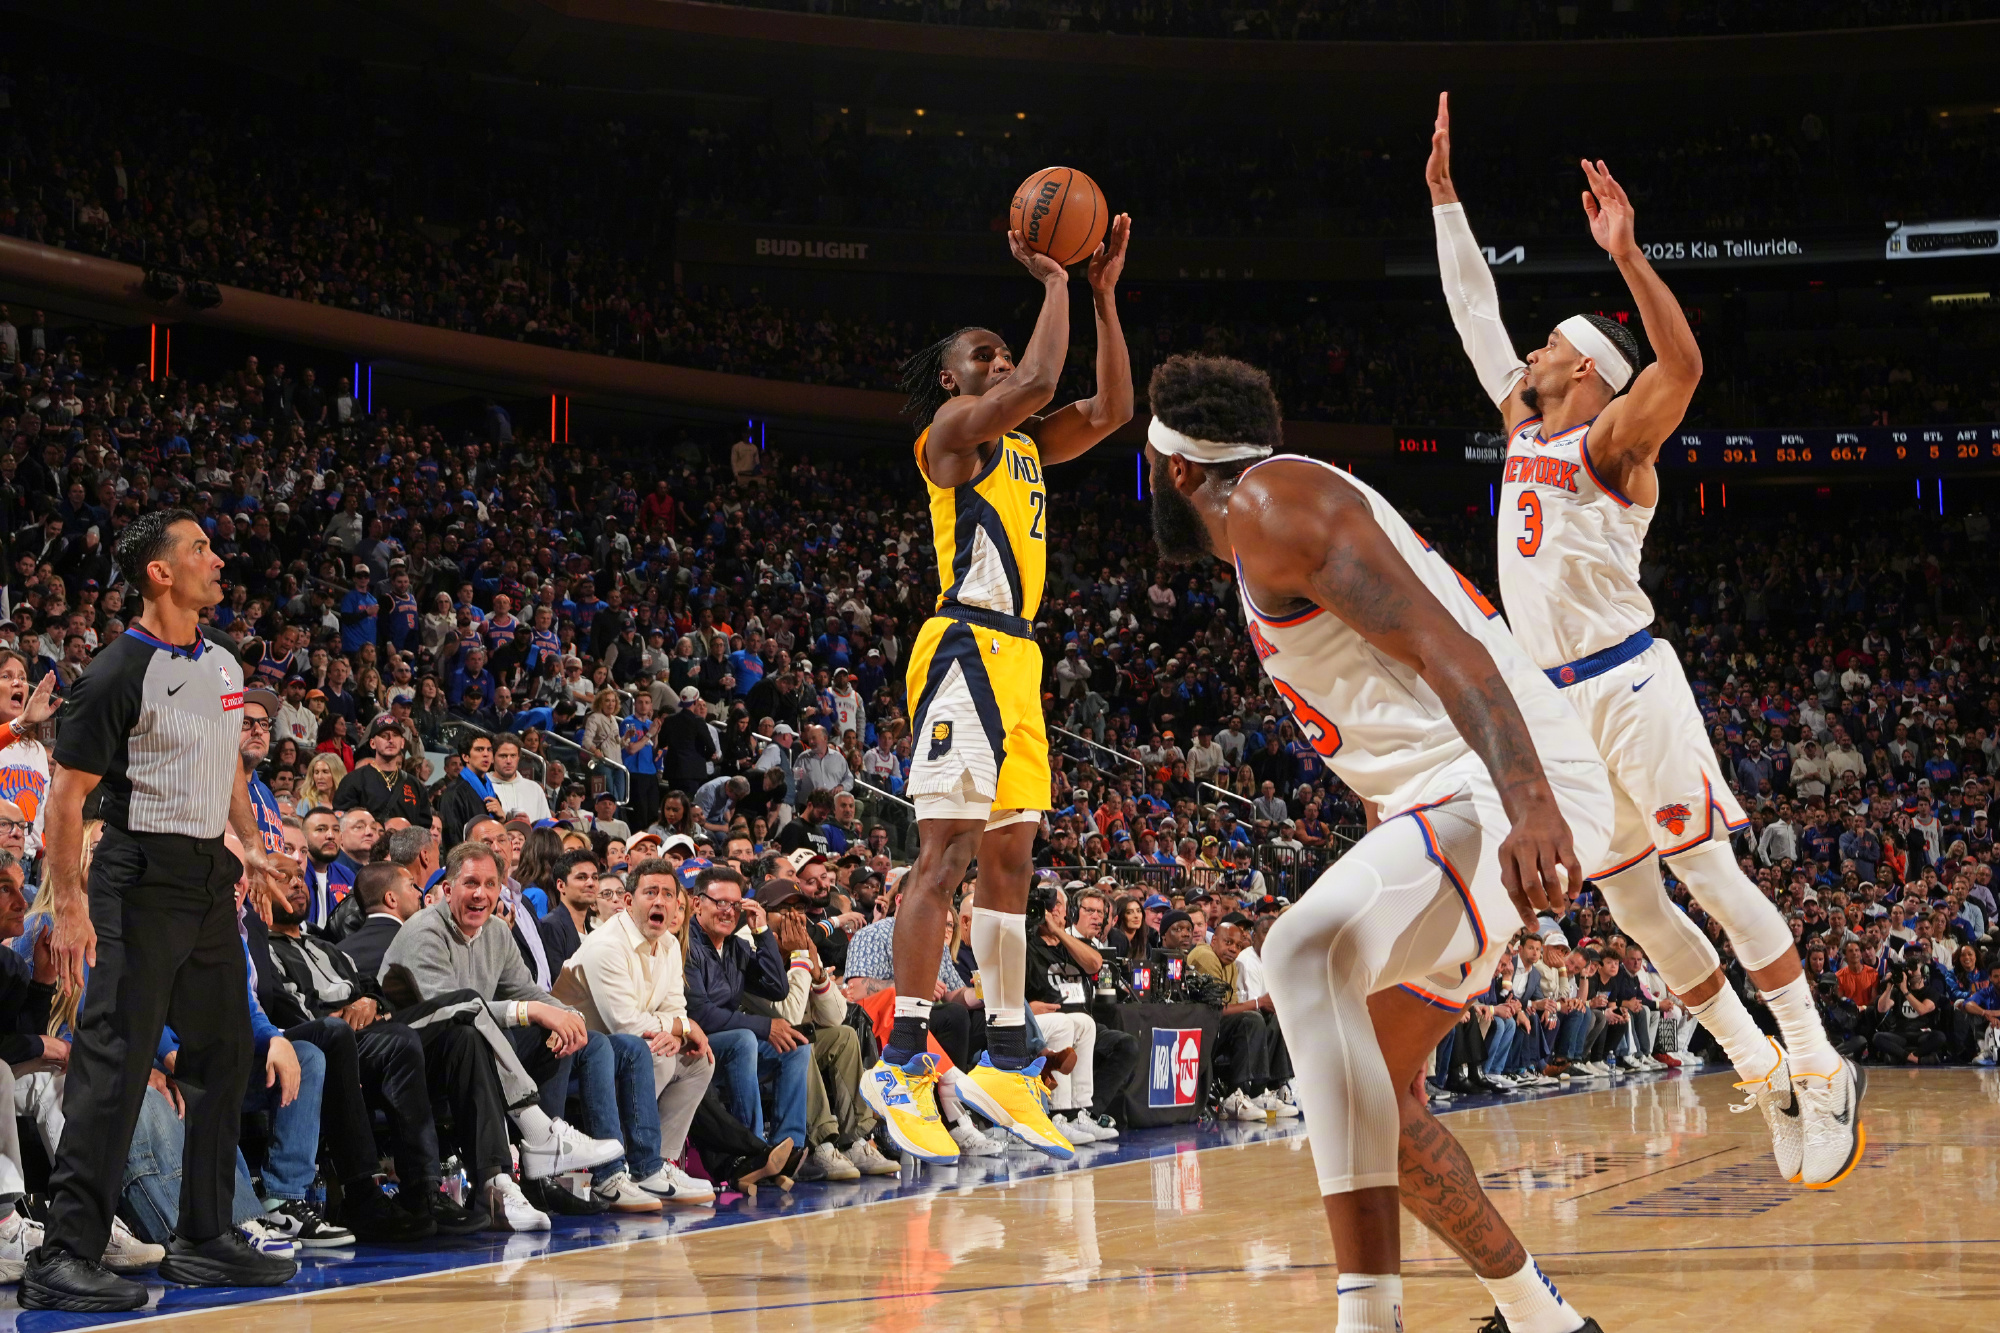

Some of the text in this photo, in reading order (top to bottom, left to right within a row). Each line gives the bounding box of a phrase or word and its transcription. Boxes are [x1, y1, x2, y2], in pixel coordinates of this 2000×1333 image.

[1028, 180, 1062, 243] Wilson
[755, 238, 869, 260] BUD LIGHT
[1642, 237, 1803, 260] 2025 Kia Telluride.
[1399, 438, 1438, 452] 10:11
[1681, 435, 1702, 446] TOL
[1725, 435, 1754, 446] 3PT%
[1780, 434, 1805, 445] FG%
[1835, 433, 1859, 444] FT%
[1892, 432, 1907, 443] TO
[1923, 431, 1944, 442] STL
[1956, 429, 1978, 441] AST
[1465, 446, 1498, 461] MADISON
[1687, 448, 1698, 463] 3
[1723, 448, 1758, 463] 39.1
[1776, 447, 1813, 462] 53.6
[1831, 446, 1867, 461] 66.7
[1896, 445, 1907, 460] 9
[1929, 444, 1940, 459] 5
[1957, 443, 1979, 459] 20
[1005, 448, 1044, 487] IND
[1029, 490, 1046, 541] 2
[1516, 490, 1544, 558] 3
[406, 613, 416, 630] 5
[840, 711, 848, 723] 3
[43, 728, 51, 740] 15
[0, 766, 45, 795] KNICKS
[594, 783, 603, 793] 17
[793, 852, 804, 864] NEW
[1153, 1045, 1170, 1091] NBA
